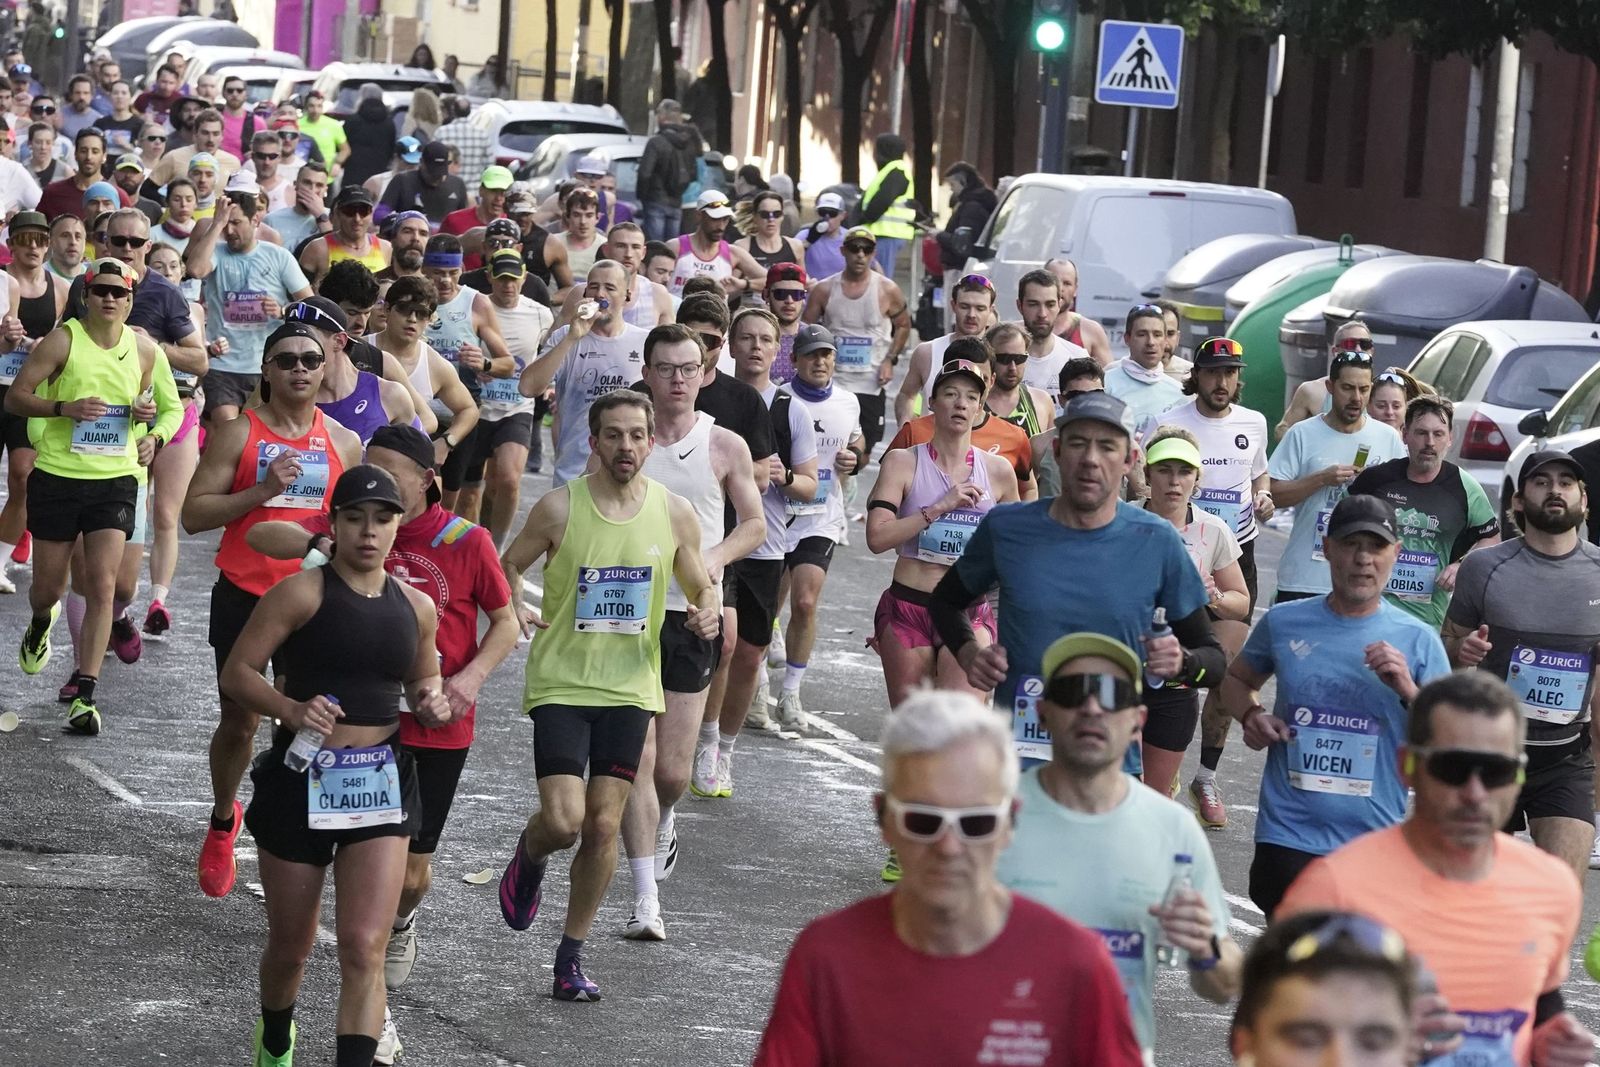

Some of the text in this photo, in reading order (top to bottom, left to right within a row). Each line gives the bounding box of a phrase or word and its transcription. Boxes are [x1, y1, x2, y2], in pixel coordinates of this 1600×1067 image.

[230, 313, 262, 321] CARLOS
[486, 389, 521, 402] VICENTE
[94, 422, 110, 430] 9021
[81, 431, 119, 444] JUANPA
[300, 486, 326, 496] JOHN
[1205, 491, 1236, 501] ZURICH
[944, 512, 980, 524] ZURICH
[944, 530, 963, 540] 7138
[1398, 552, 1432, 564] ZURICH
[603, 570, 645, 580] ZURICH
[1397, 568, 1415, 578] 8113
[603, 590, 626, 599] 6767
[593, 602, 635, 617] AITOR
[1540, 655, 1582, 669] ZURICH
[1537, 675, 1561, 688] 8078
[1526, 688, 1564, 706] ALEC
[1316, 713, 1369, 730] ZURICH
[1023, 722, 1052, 740] HE
[1315, 738, 1343, 751] 8477
[341, 751, 387, 765] ZURICH
[1303, 753, 1352, 774] VICEN
[342, 777, 366, 789] 5481
[319, 791, 391, 809] CLAUDIA
